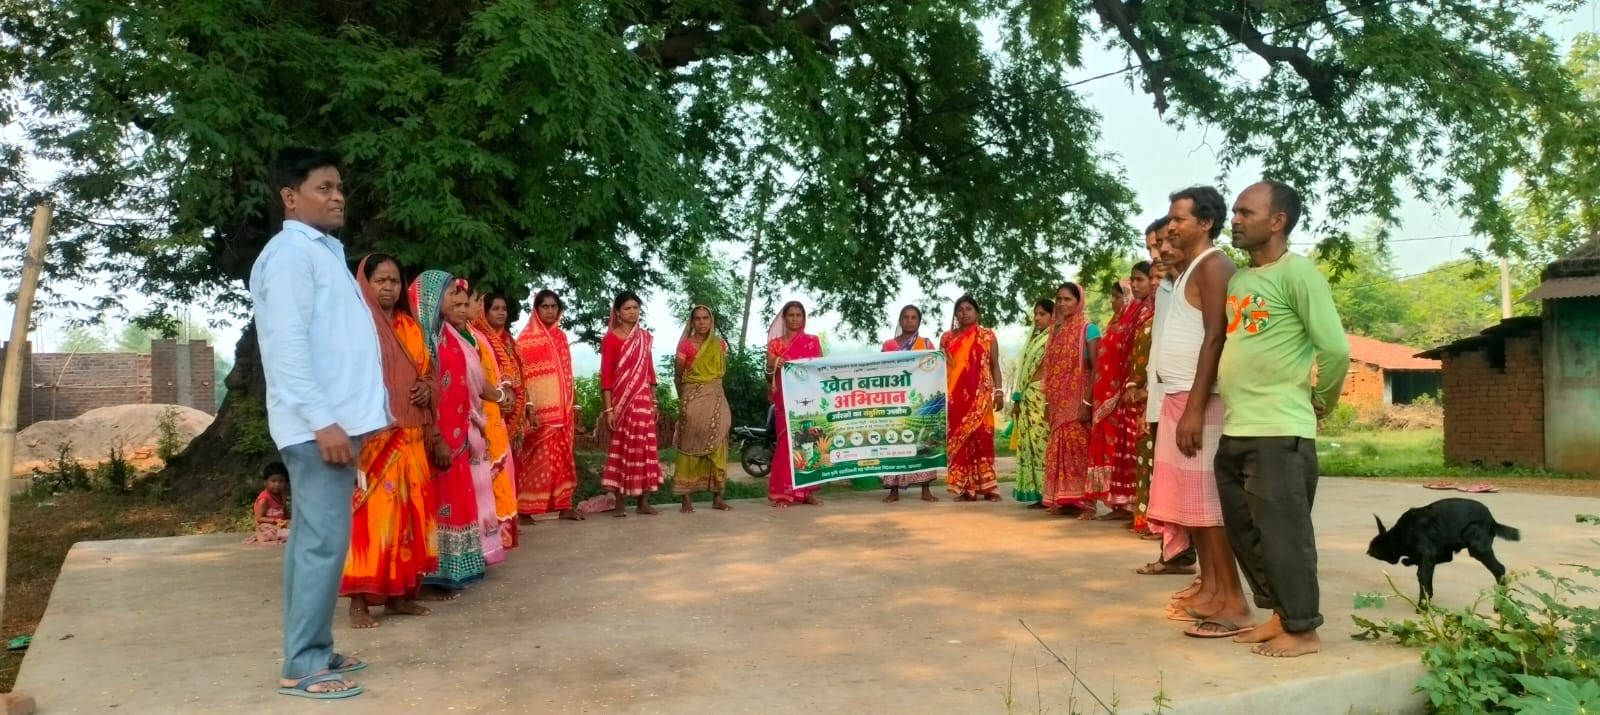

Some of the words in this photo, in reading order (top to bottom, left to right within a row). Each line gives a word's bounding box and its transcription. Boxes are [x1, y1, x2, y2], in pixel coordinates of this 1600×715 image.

[819, 375, 853, 394] खेत
[857, 370, 913, 390] बचाओ
[834, 390, 907, 409] अभियान
